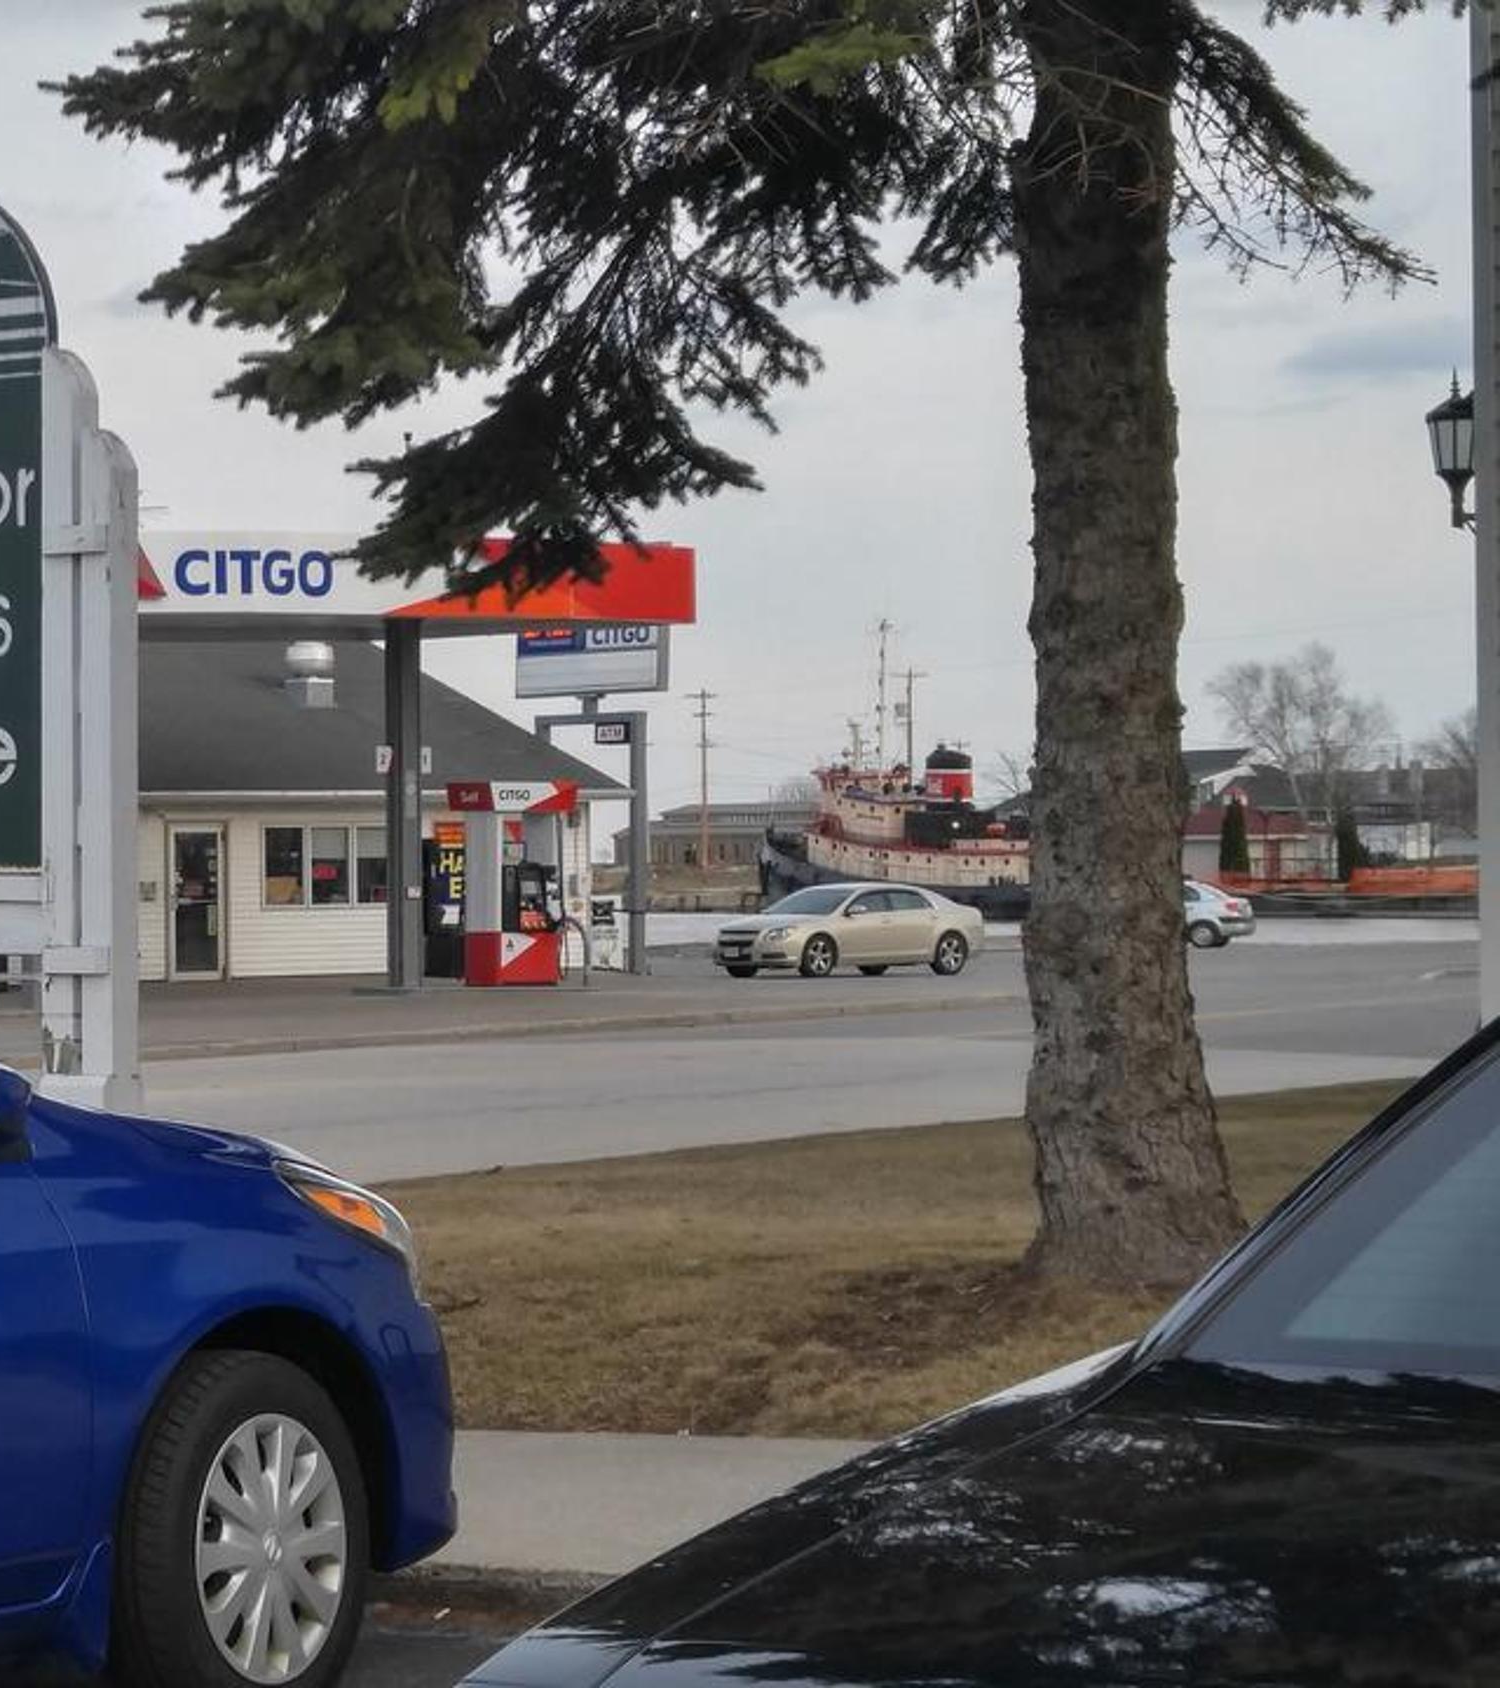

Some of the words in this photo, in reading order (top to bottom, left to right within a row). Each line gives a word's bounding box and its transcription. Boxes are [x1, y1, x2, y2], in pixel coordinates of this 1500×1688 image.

[174, 549, 333, 597] CITGO
[600, 727, 622, 737] ATM
[499, 789, 531, 801] CITGO
